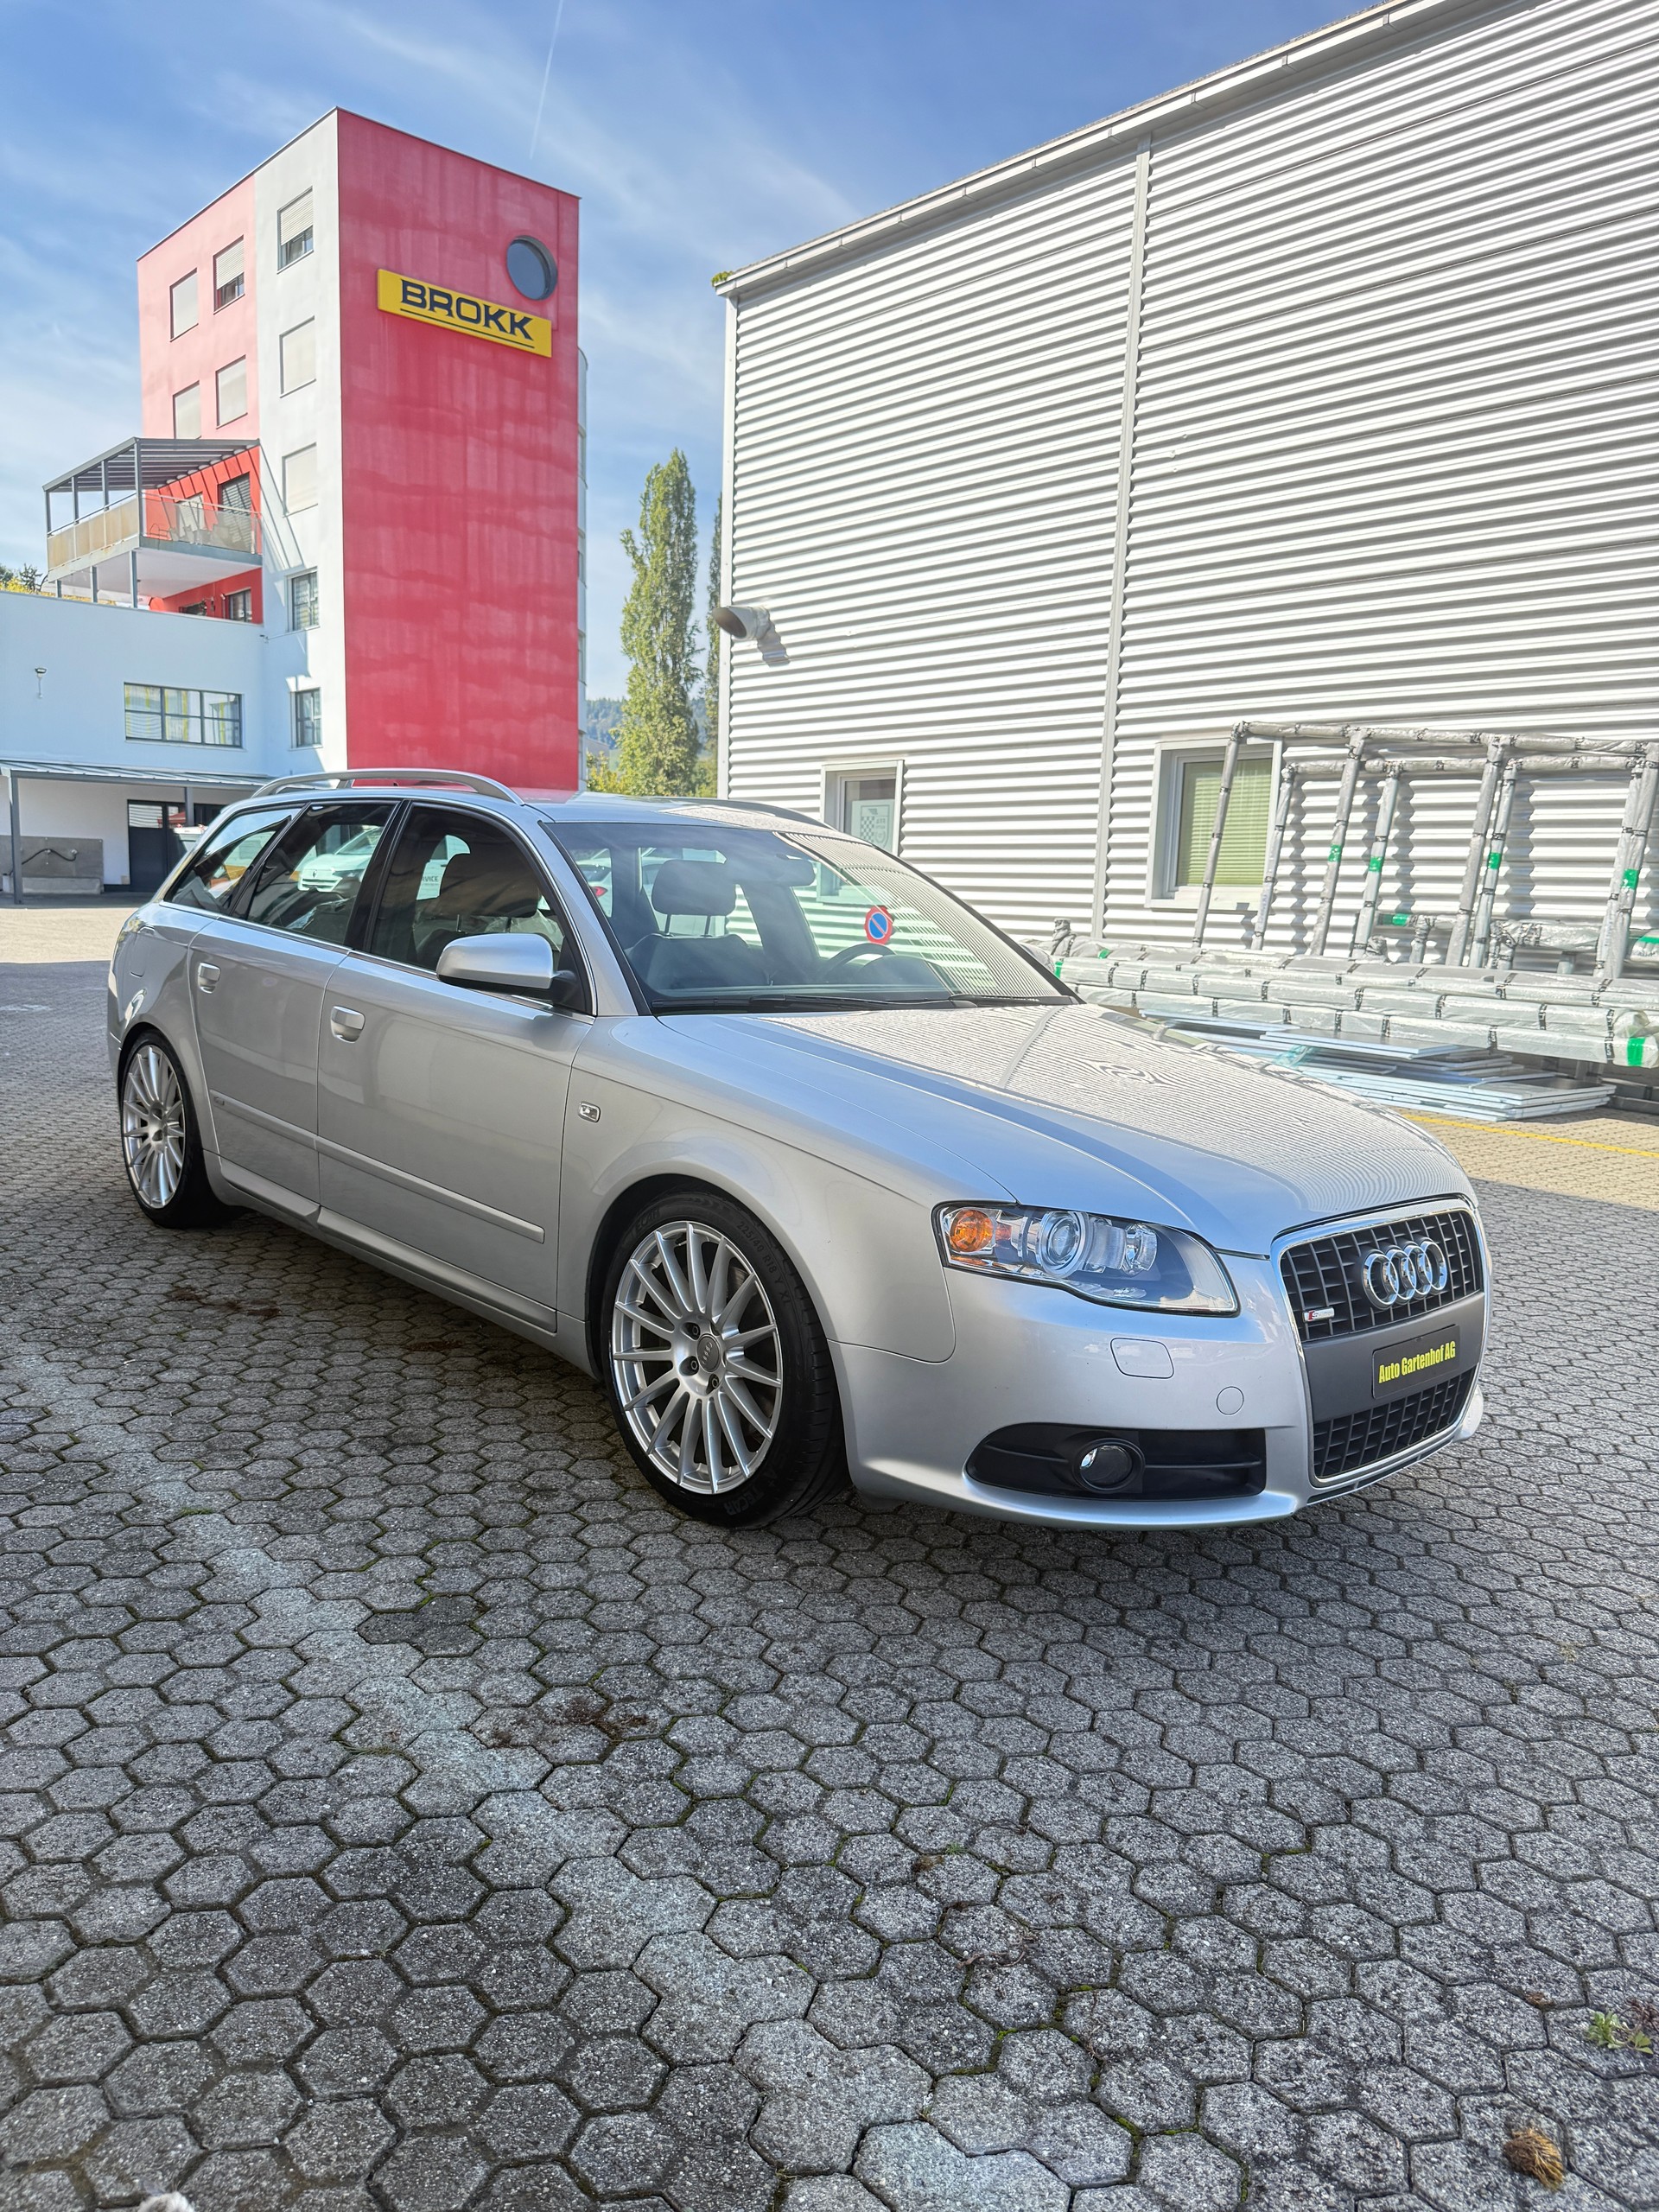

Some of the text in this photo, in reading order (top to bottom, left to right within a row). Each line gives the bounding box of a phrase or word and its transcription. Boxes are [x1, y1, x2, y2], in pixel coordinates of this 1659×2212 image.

[400, 278, 534, 341] BROKK
[1378, 1340, 1456, 1384] Auto Gartenhof AG
